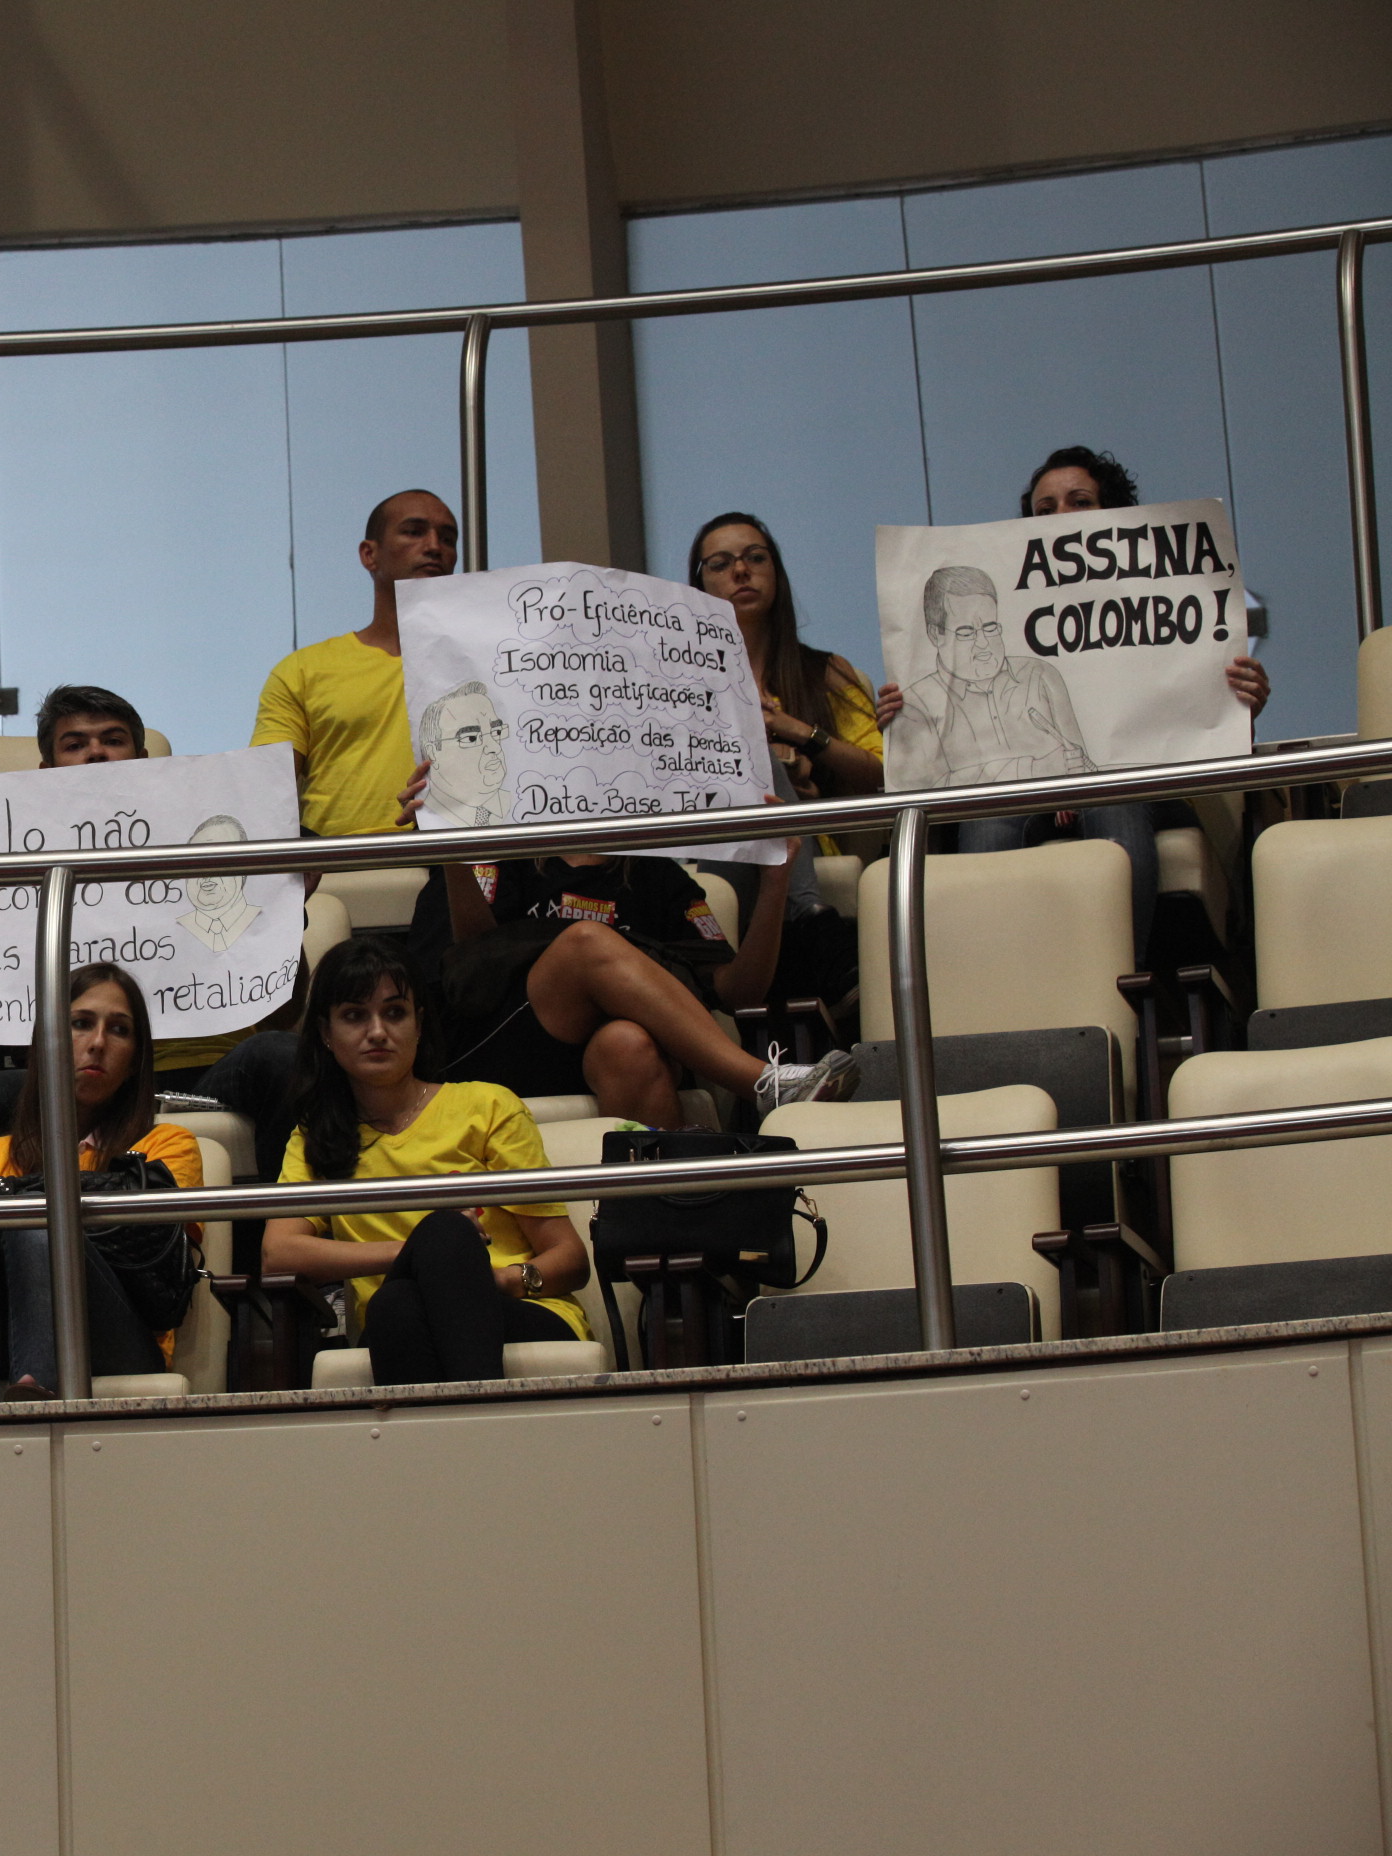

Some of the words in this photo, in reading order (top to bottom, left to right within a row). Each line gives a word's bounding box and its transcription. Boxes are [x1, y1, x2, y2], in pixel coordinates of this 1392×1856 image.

[1014, 521, 1235, 590] ASSINA,
[516, 587, 684, 637] Pró-Eficiência
[696, 620, 736, 646] para
[499, 650, 628, 675] Isonomia
[660, 636, 726, 673] todos!
[534, 682, 580, 701] nas
[589, 679, 714, 712] gratificações!
[522, 718, 631, 754] Reposição
[640, 722, 675, 748] das
[688, 730, 742, 755] perdas
[655, 752, 744, 777] salariais!
[520, 783, 663, 820] Data-Base
[70, 809, 152, 850] não
[69, 925, 176, 965] arados
[153, 955, 300, 1017] retaliação
